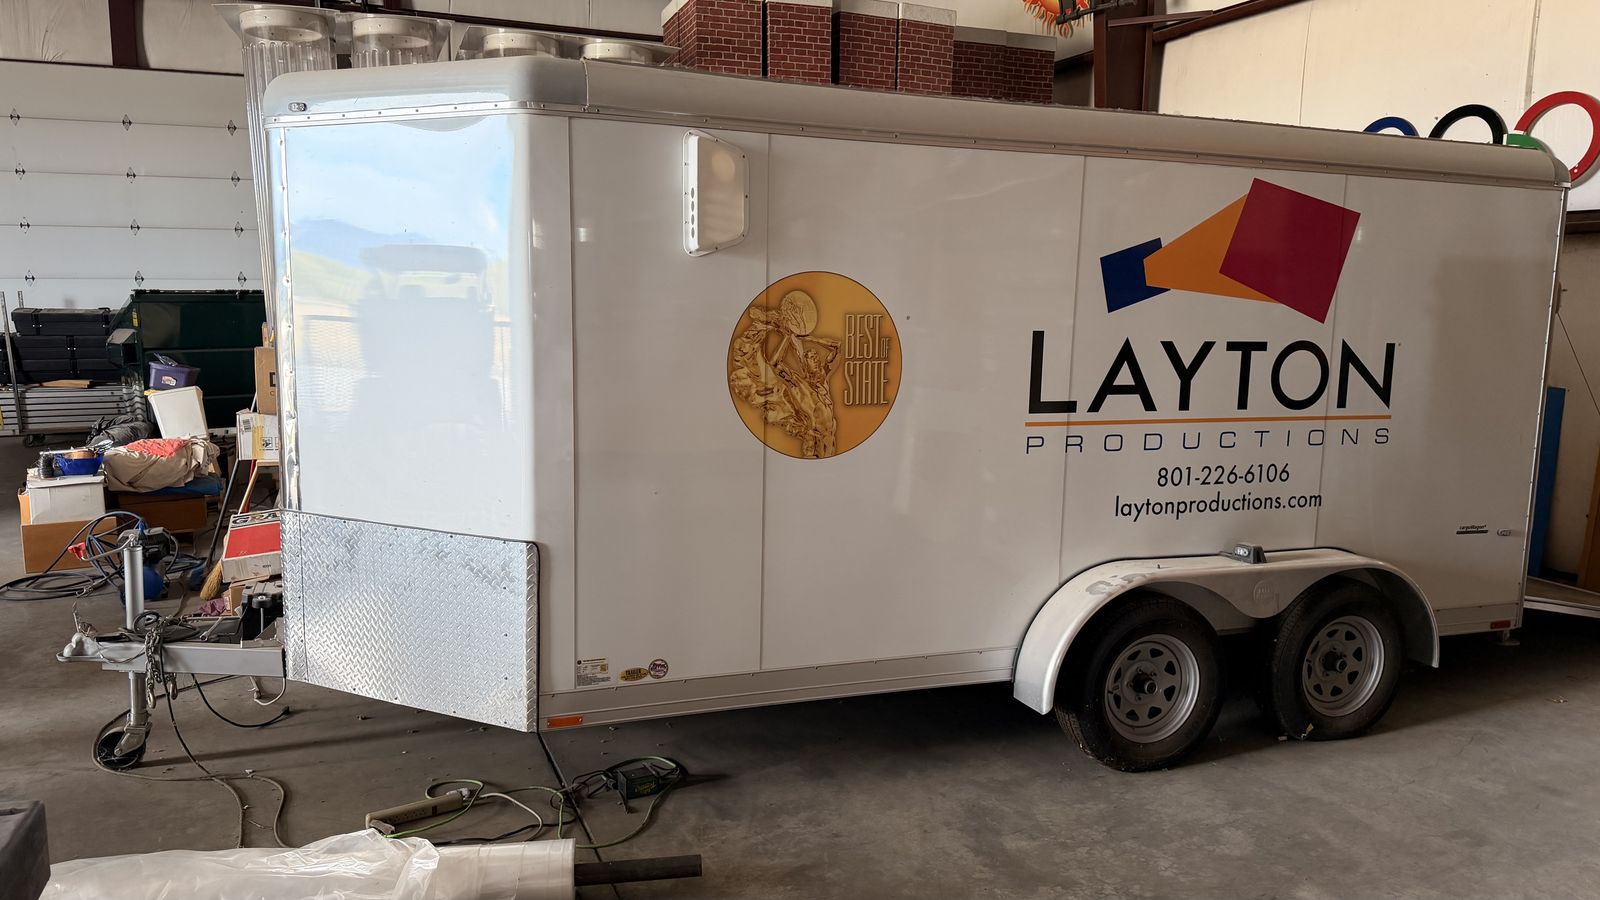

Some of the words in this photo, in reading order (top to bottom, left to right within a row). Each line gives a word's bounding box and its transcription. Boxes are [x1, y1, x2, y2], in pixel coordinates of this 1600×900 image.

[845, 314, 883, 359] BEST
[880, 337, 889, 359] OF
[844, 360, 889, 406] STATE
[1028, 330, 1396, 414] LAYTON
[1026, 428, 1390, 454] PRODUCTIONS
[1157, 463, 1291, 487] 801-226-6106
[1115, 491, 1323, 522] laytonproductions.com
